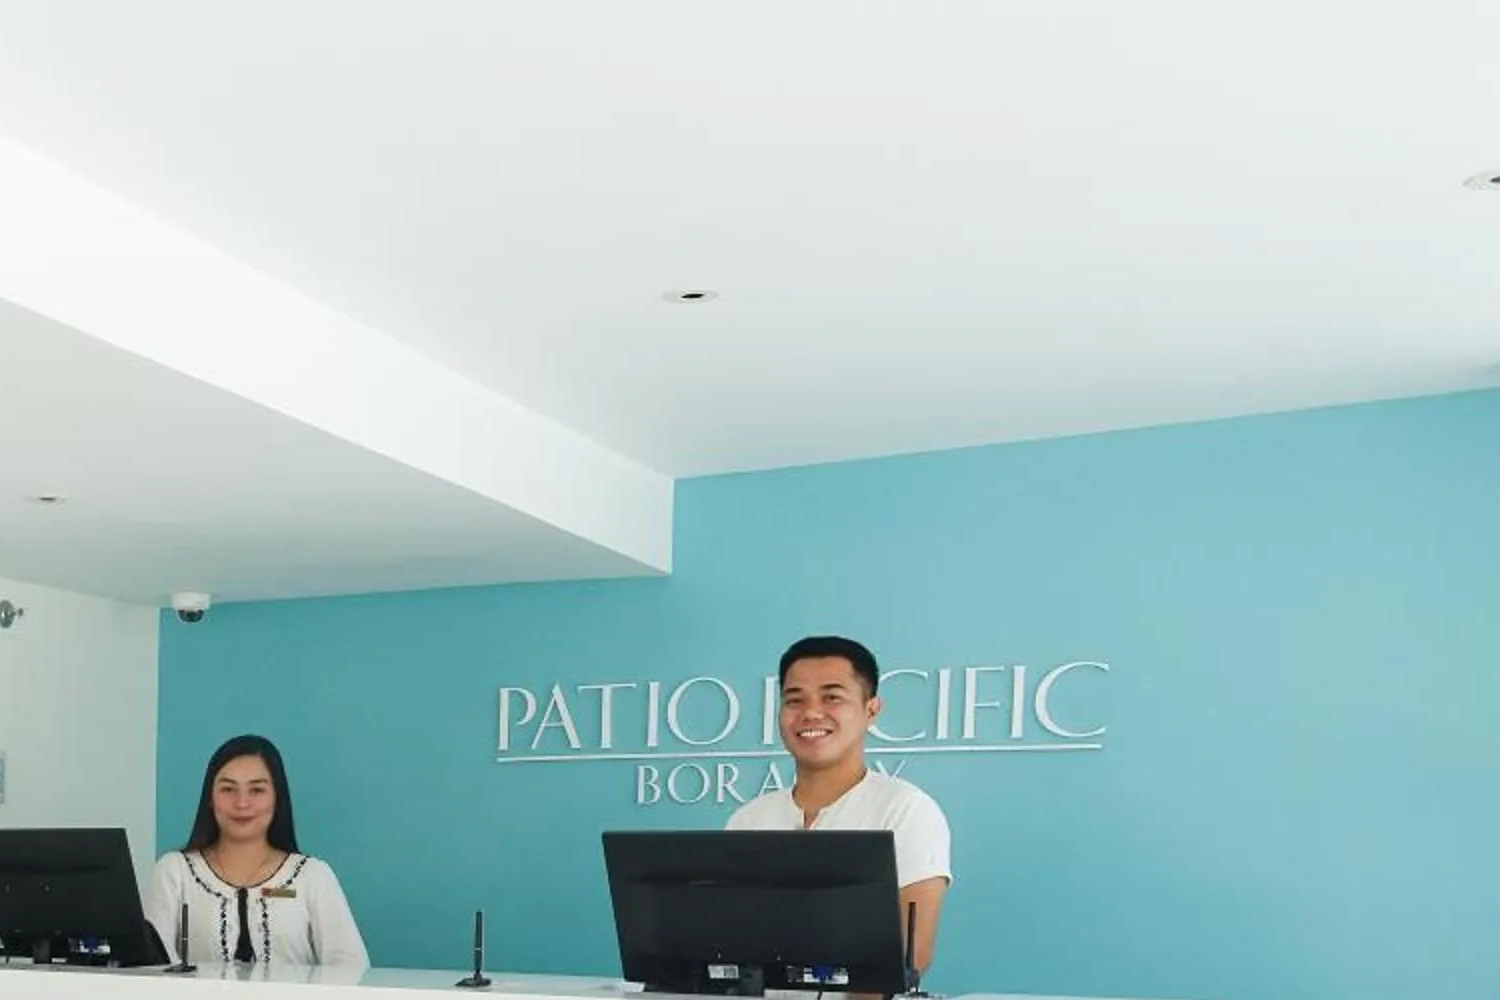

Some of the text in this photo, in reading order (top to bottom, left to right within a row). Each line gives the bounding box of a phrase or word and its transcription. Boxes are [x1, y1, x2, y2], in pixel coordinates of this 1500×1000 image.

[497, 661, 1110, 751] PATIO CIFIC
[636, 758, 906, 804] BORAY
